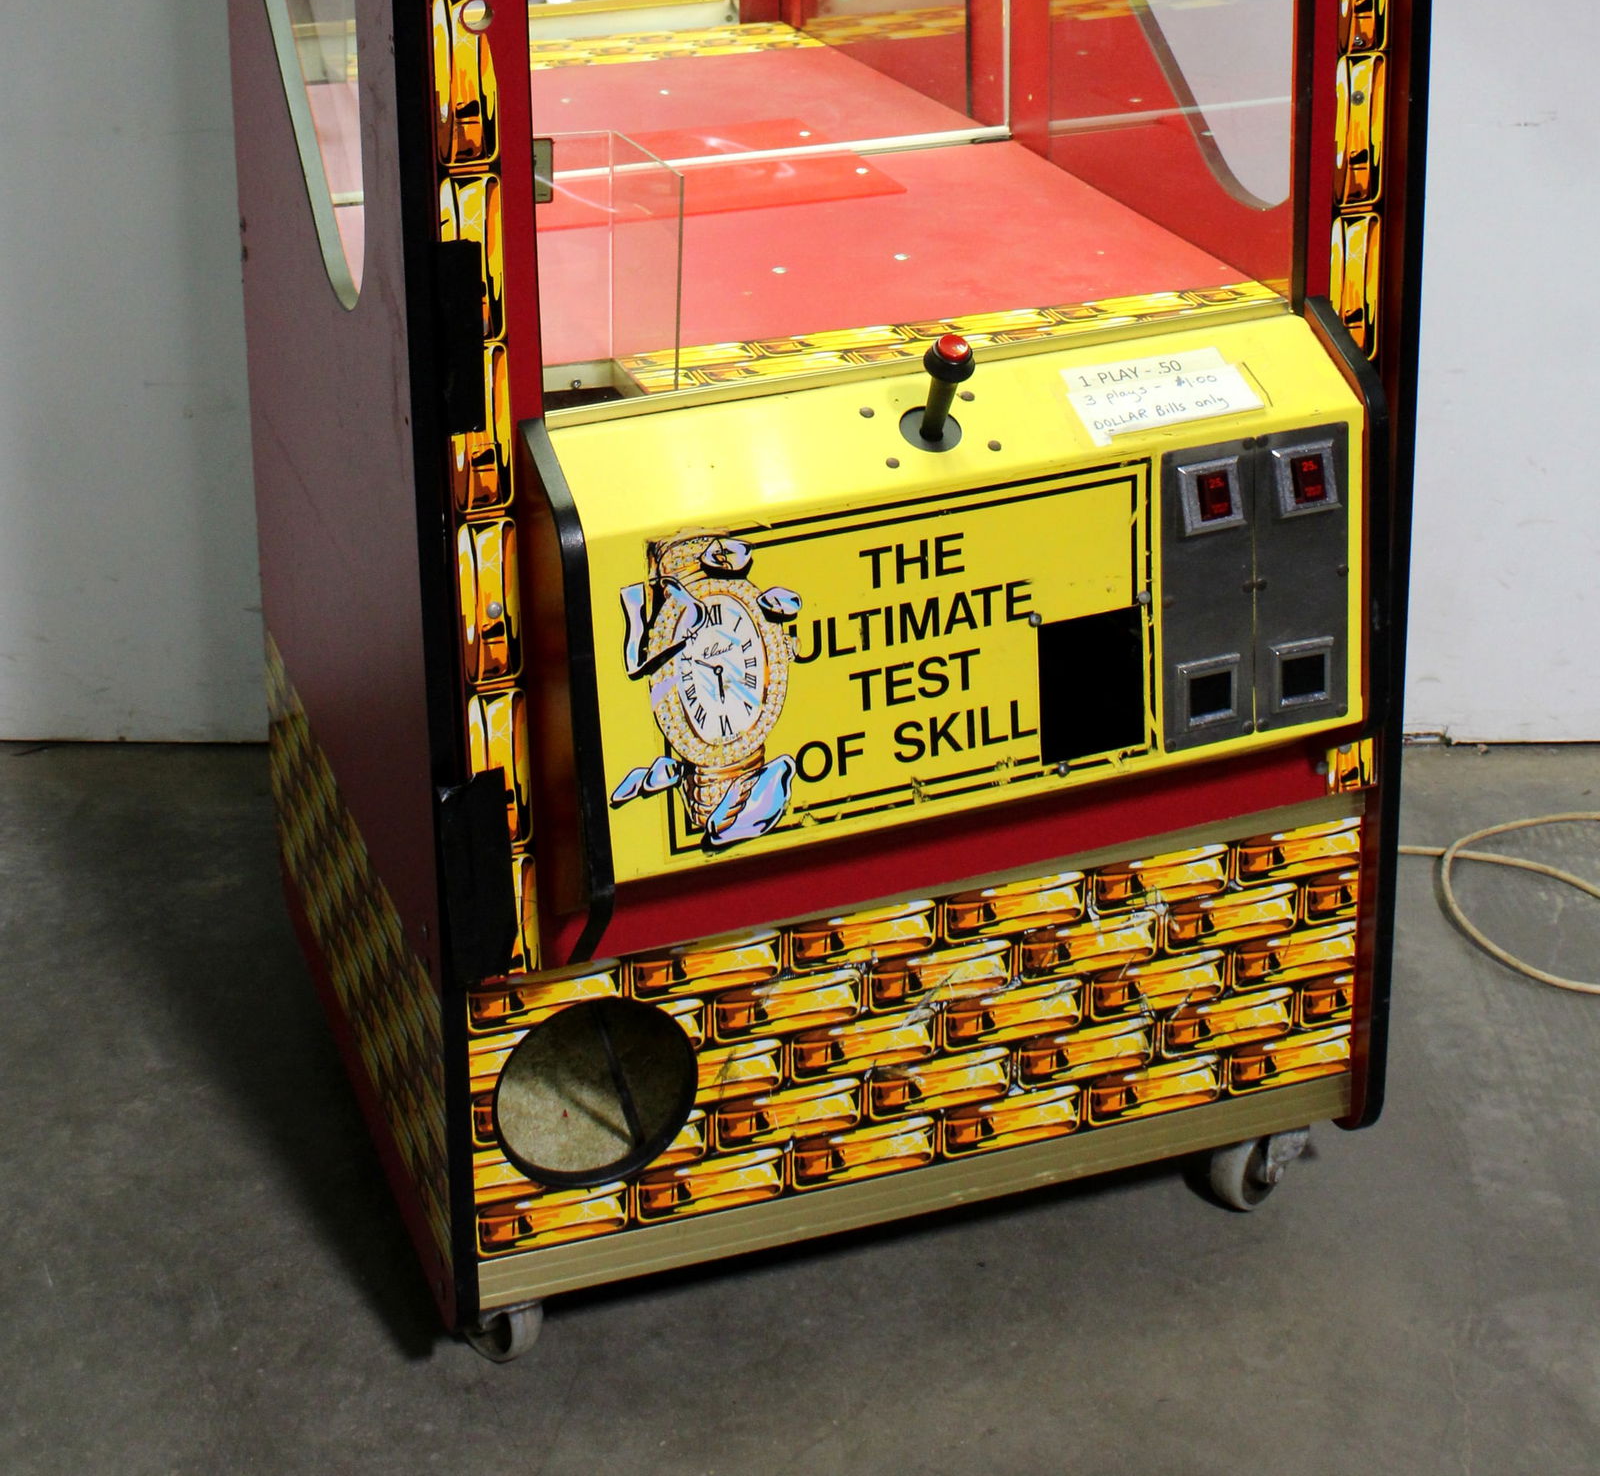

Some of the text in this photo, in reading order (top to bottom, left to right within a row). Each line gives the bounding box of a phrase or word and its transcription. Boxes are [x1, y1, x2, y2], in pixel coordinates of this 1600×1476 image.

[1078, 375, 1091, 388] 1
[1097, 366, 1139, 384] PLAY
[1157, 360, 1182, 375] .50
[1084, 395, 1097, 406] 3
[1106, 386, 1148, 405] plays
[1093, 394, 1230, 431] DOLLAR Bills only
[859, 533, 965, 589] THE
[704, 604, 723, 628] XII
[788, 580, 1035, 664] ULTIMATE
[849, 649, 981, 712] TEST
[796, 700, 1038, 783] OF SKILL
